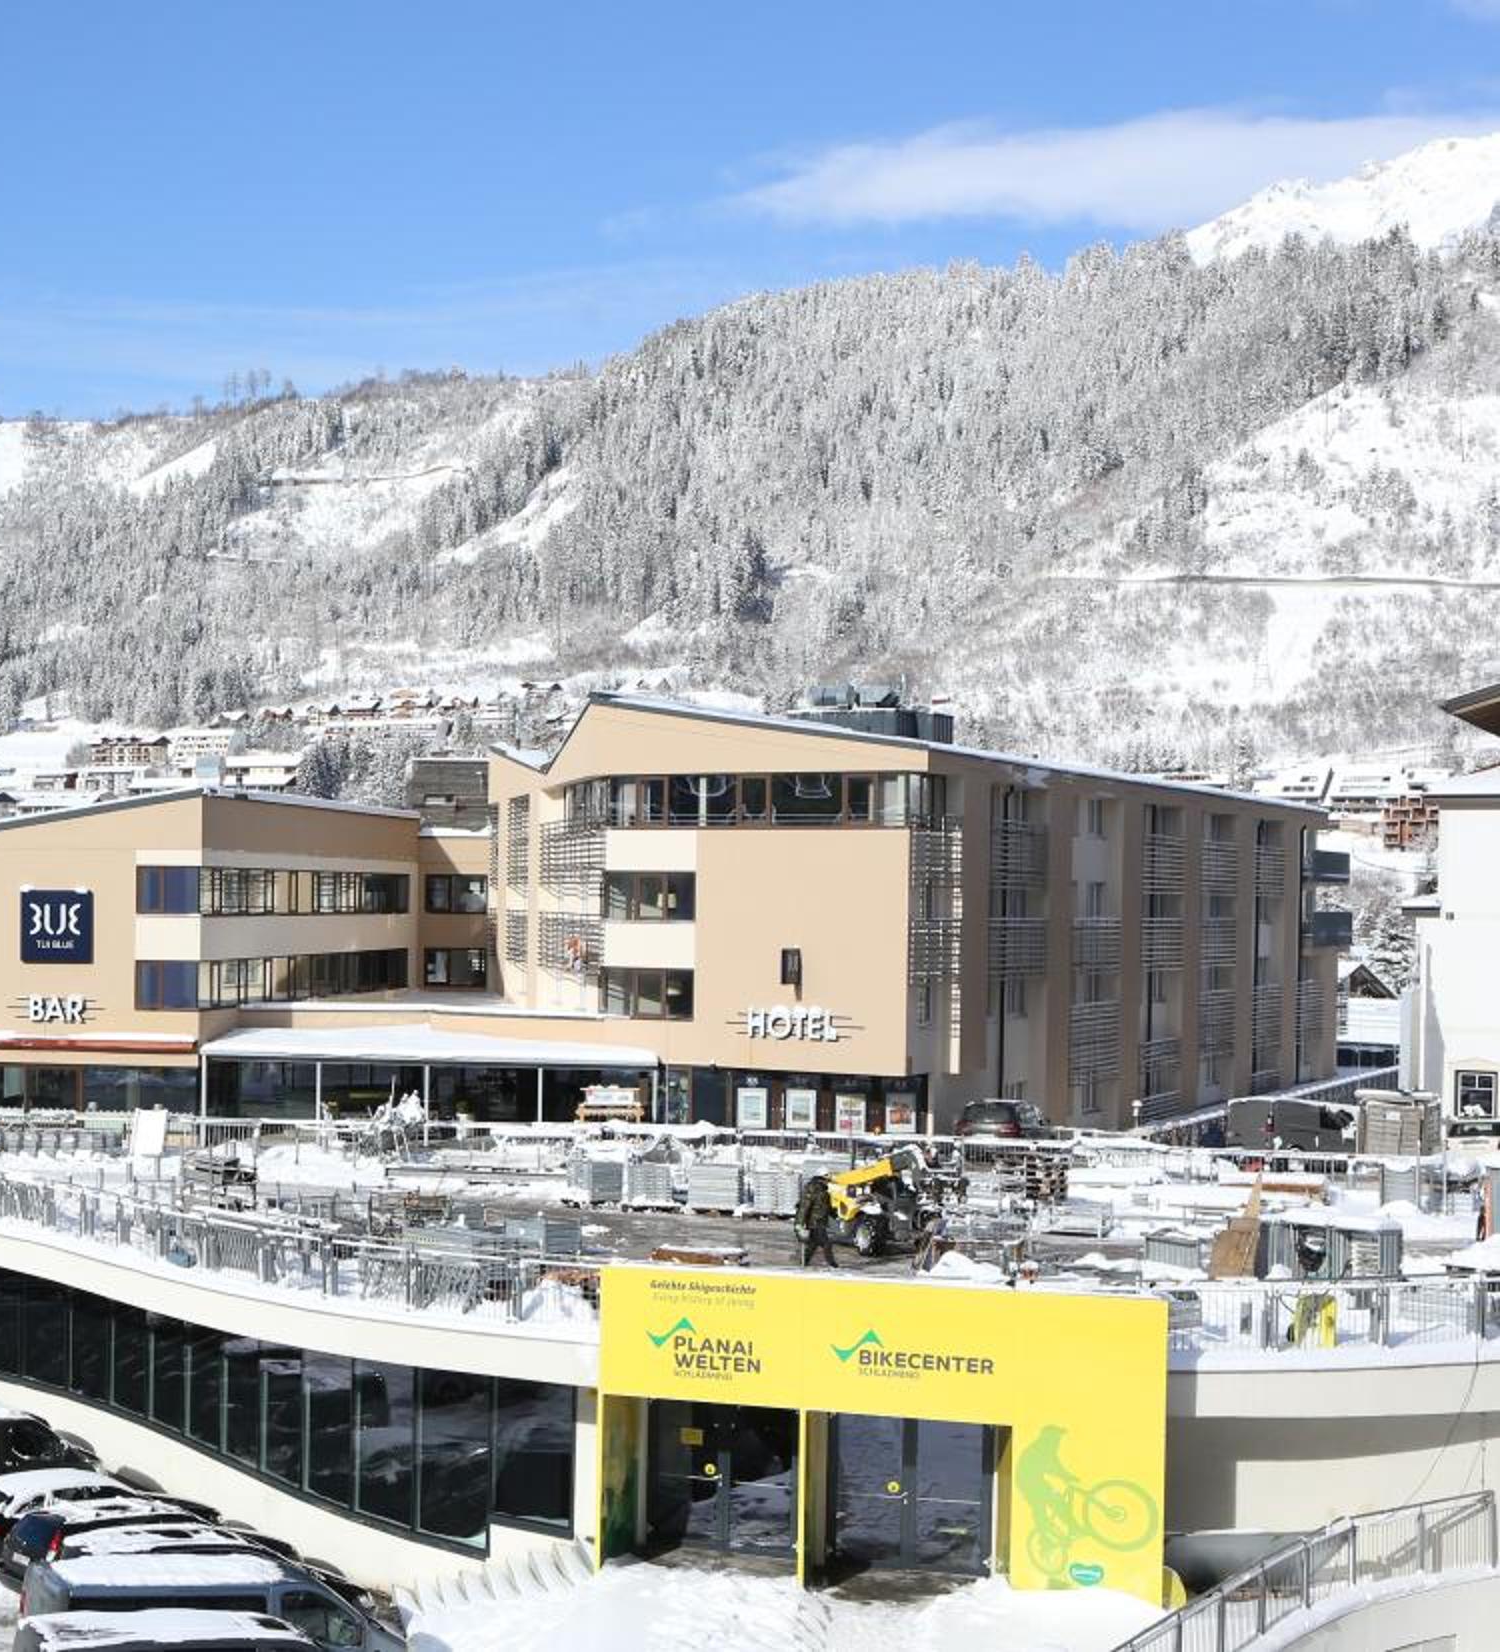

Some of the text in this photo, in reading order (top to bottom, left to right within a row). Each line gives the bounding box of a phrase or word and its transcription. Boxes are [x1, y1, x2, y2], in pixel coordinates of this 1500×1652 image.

[36, 940, 51, 949] TUI
[29, 994, 85, 1023] BAR
[747, 1006, 839, 1042] HOTEL
[674, 1335, 753, 1356] PLANAI
[674, 1353, 761, 1374] WELTEN
[859, 1349, 994, 1375] BIKECENTER
